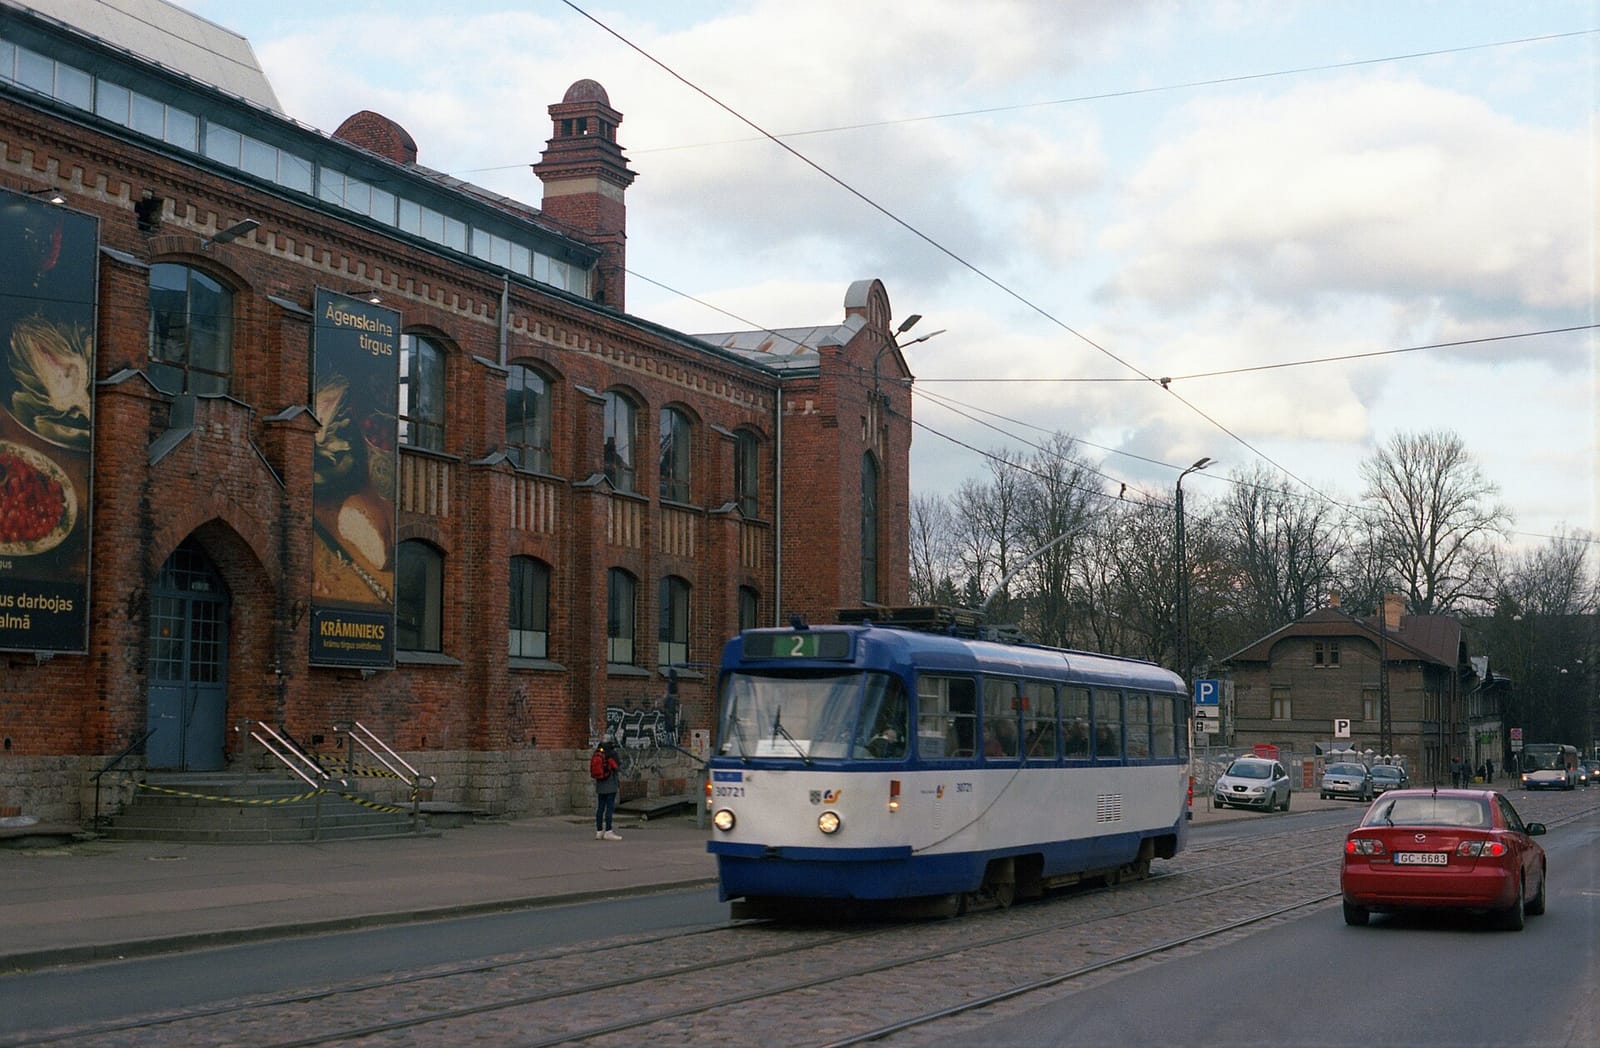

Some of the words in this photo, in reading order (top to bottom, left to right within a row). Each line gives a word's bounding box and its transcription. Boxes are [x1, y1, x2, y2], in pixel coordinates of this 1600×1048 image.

[325, 302, 393, 337] Āgenskalna
[359, 333, 393, 356] tirgus
[17, 592, 73, 613] darbojas
[320, 619, 385, 640] KRĀMINIEKS
[791, 635, 804, 656] 2
[1200, 682, 1214, 702] P
[1338, 720, 1348, 733] P
[715, 786, 745, 797] 30721
